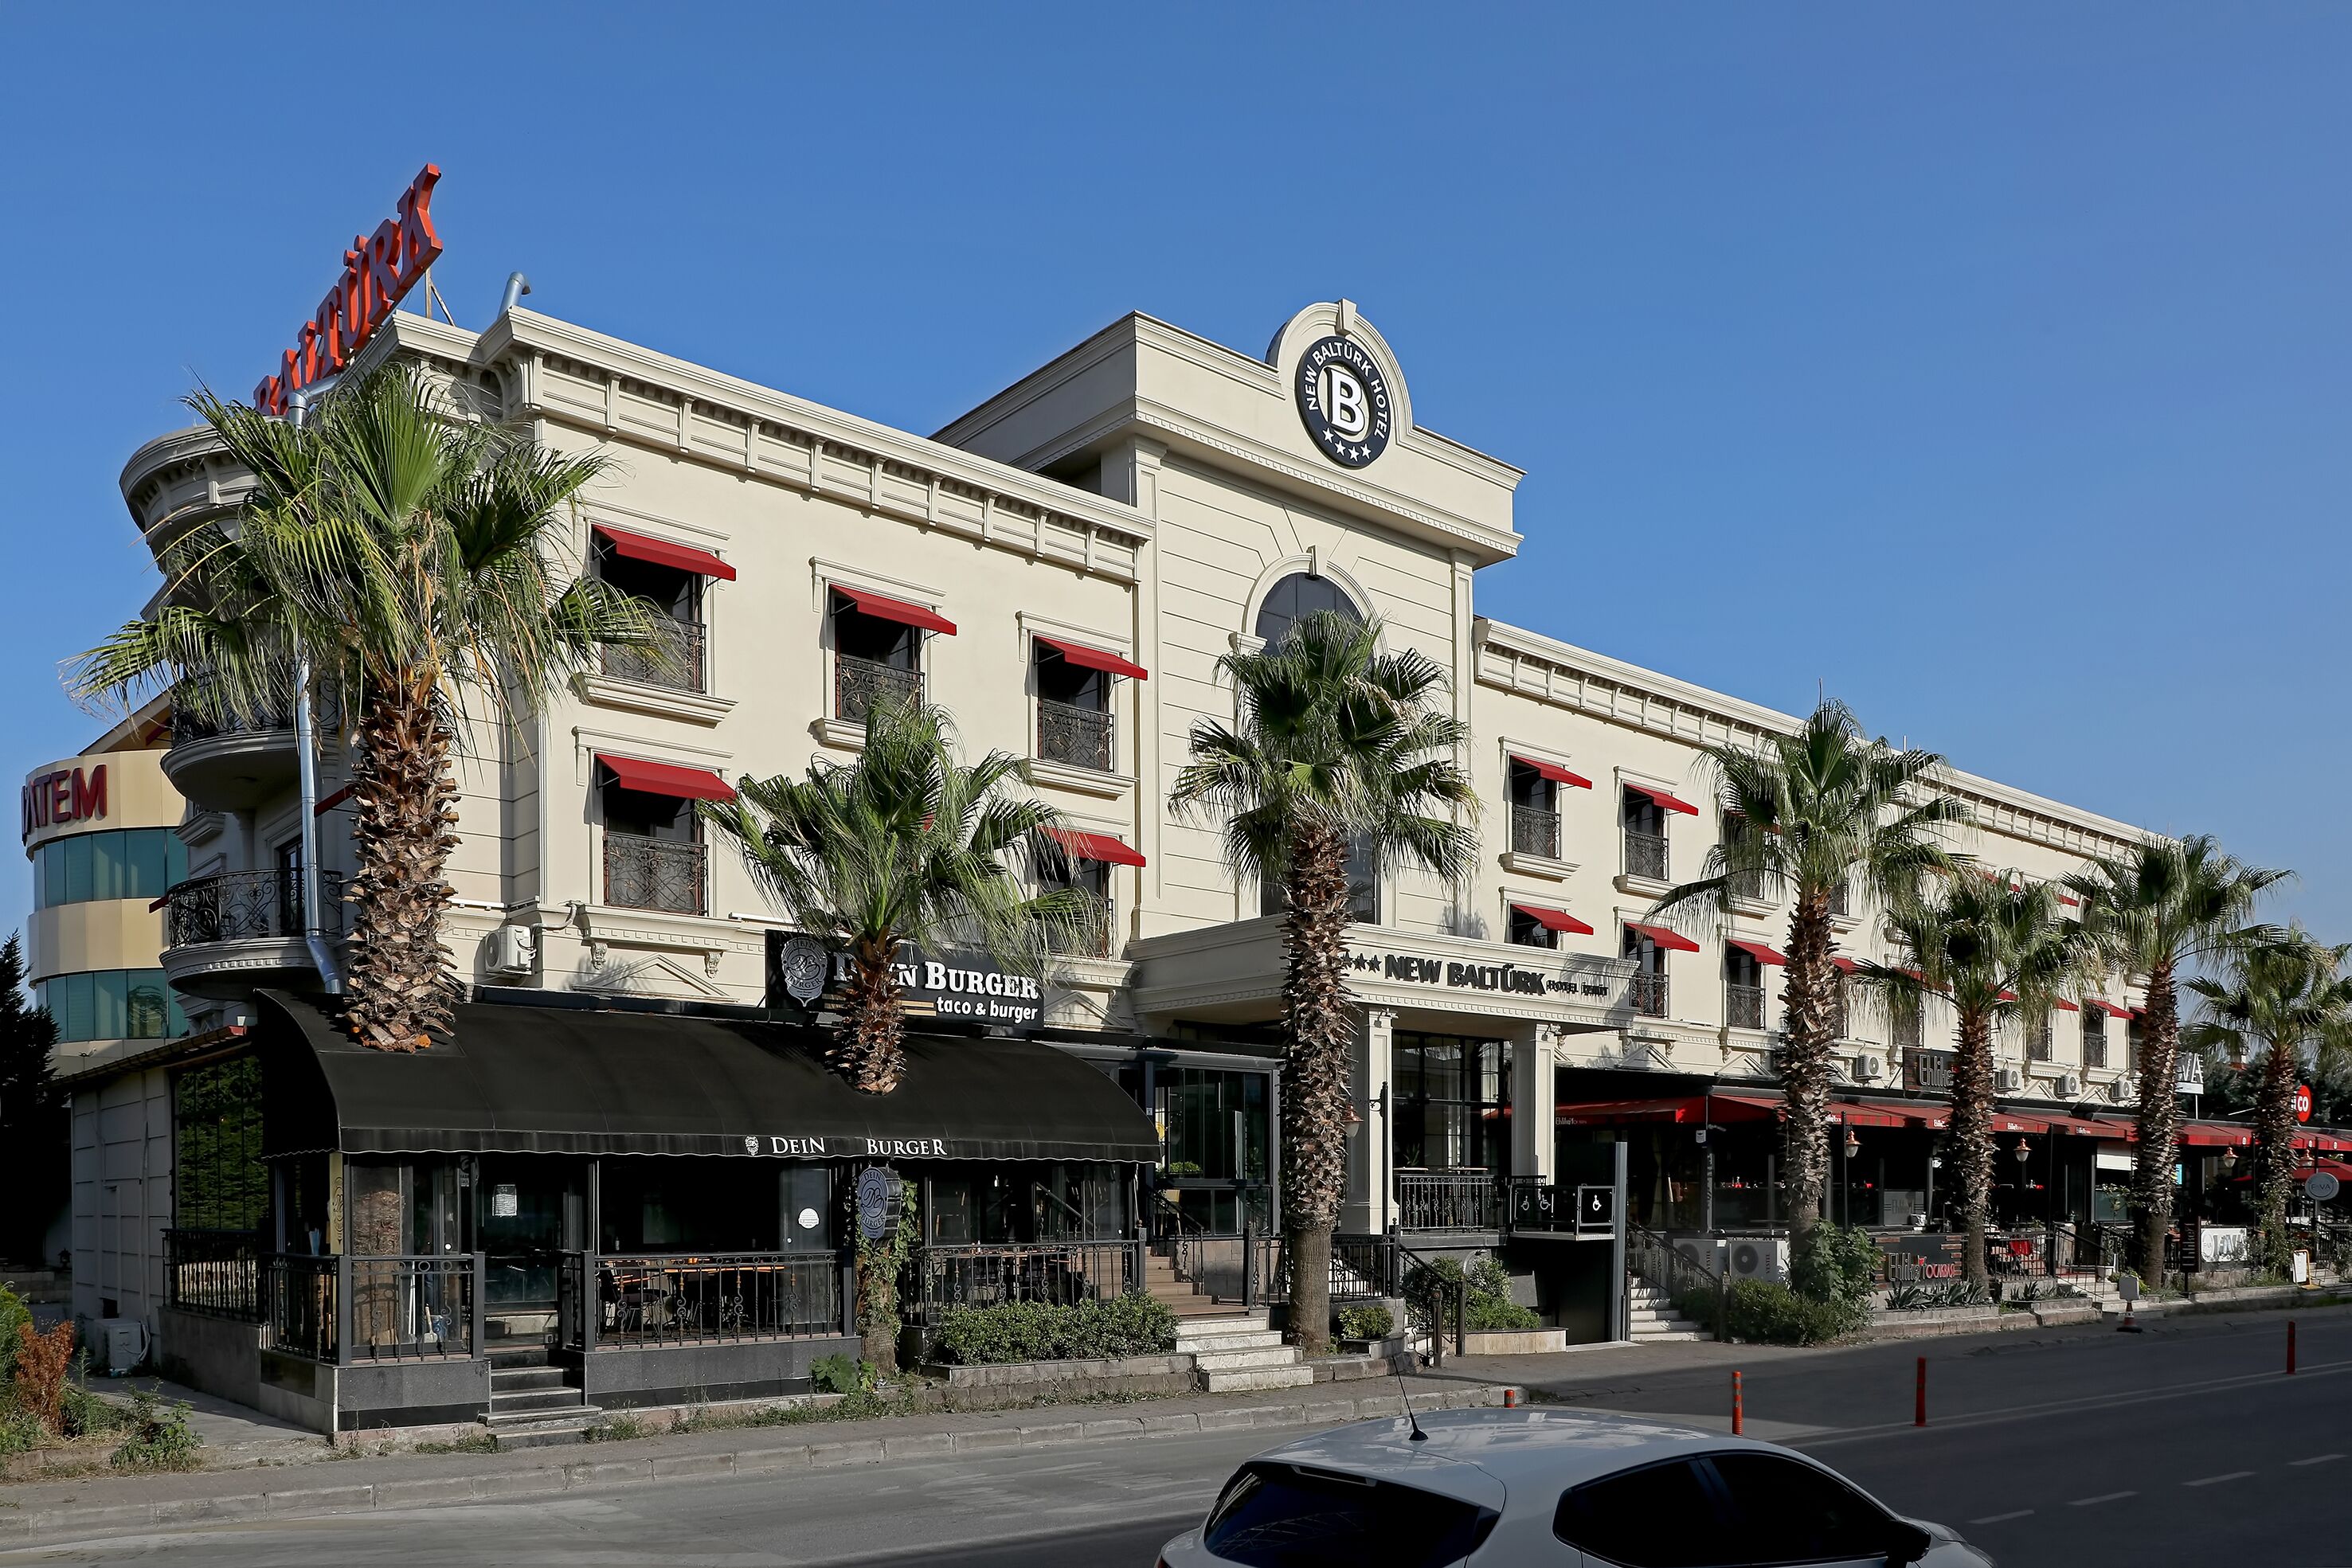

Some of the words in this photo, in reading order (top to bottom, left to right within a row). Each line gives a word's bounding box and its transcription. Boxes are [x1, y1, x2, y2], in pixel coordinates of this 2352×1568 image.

[1305, 365, 1318, 411] NEW
[1313, 341, 1373, 377] BALTÜRK
[1370, 378, 1387, 439] HOTEL
[1330, 369, 1366, 433] B
[787, 976, 821, 988] BURGER
[925, 960, 1039, 1000] BURGER
[1384, 954, 1442, 984] NEW
[1447, 962, 1548, 995] BALTÜRK
[936, 995, 971, 1015] taco
[975, 1003, 986, 1015] &
[990, 1003, 1039, 1024] burger
[770, 1136, 825, 1154] DEIN
[866, 1138, 948, 1155] BURGER
[863, 1171, 881, 1181] DEIN
[862, 1214, 885, 1227] BURGER
